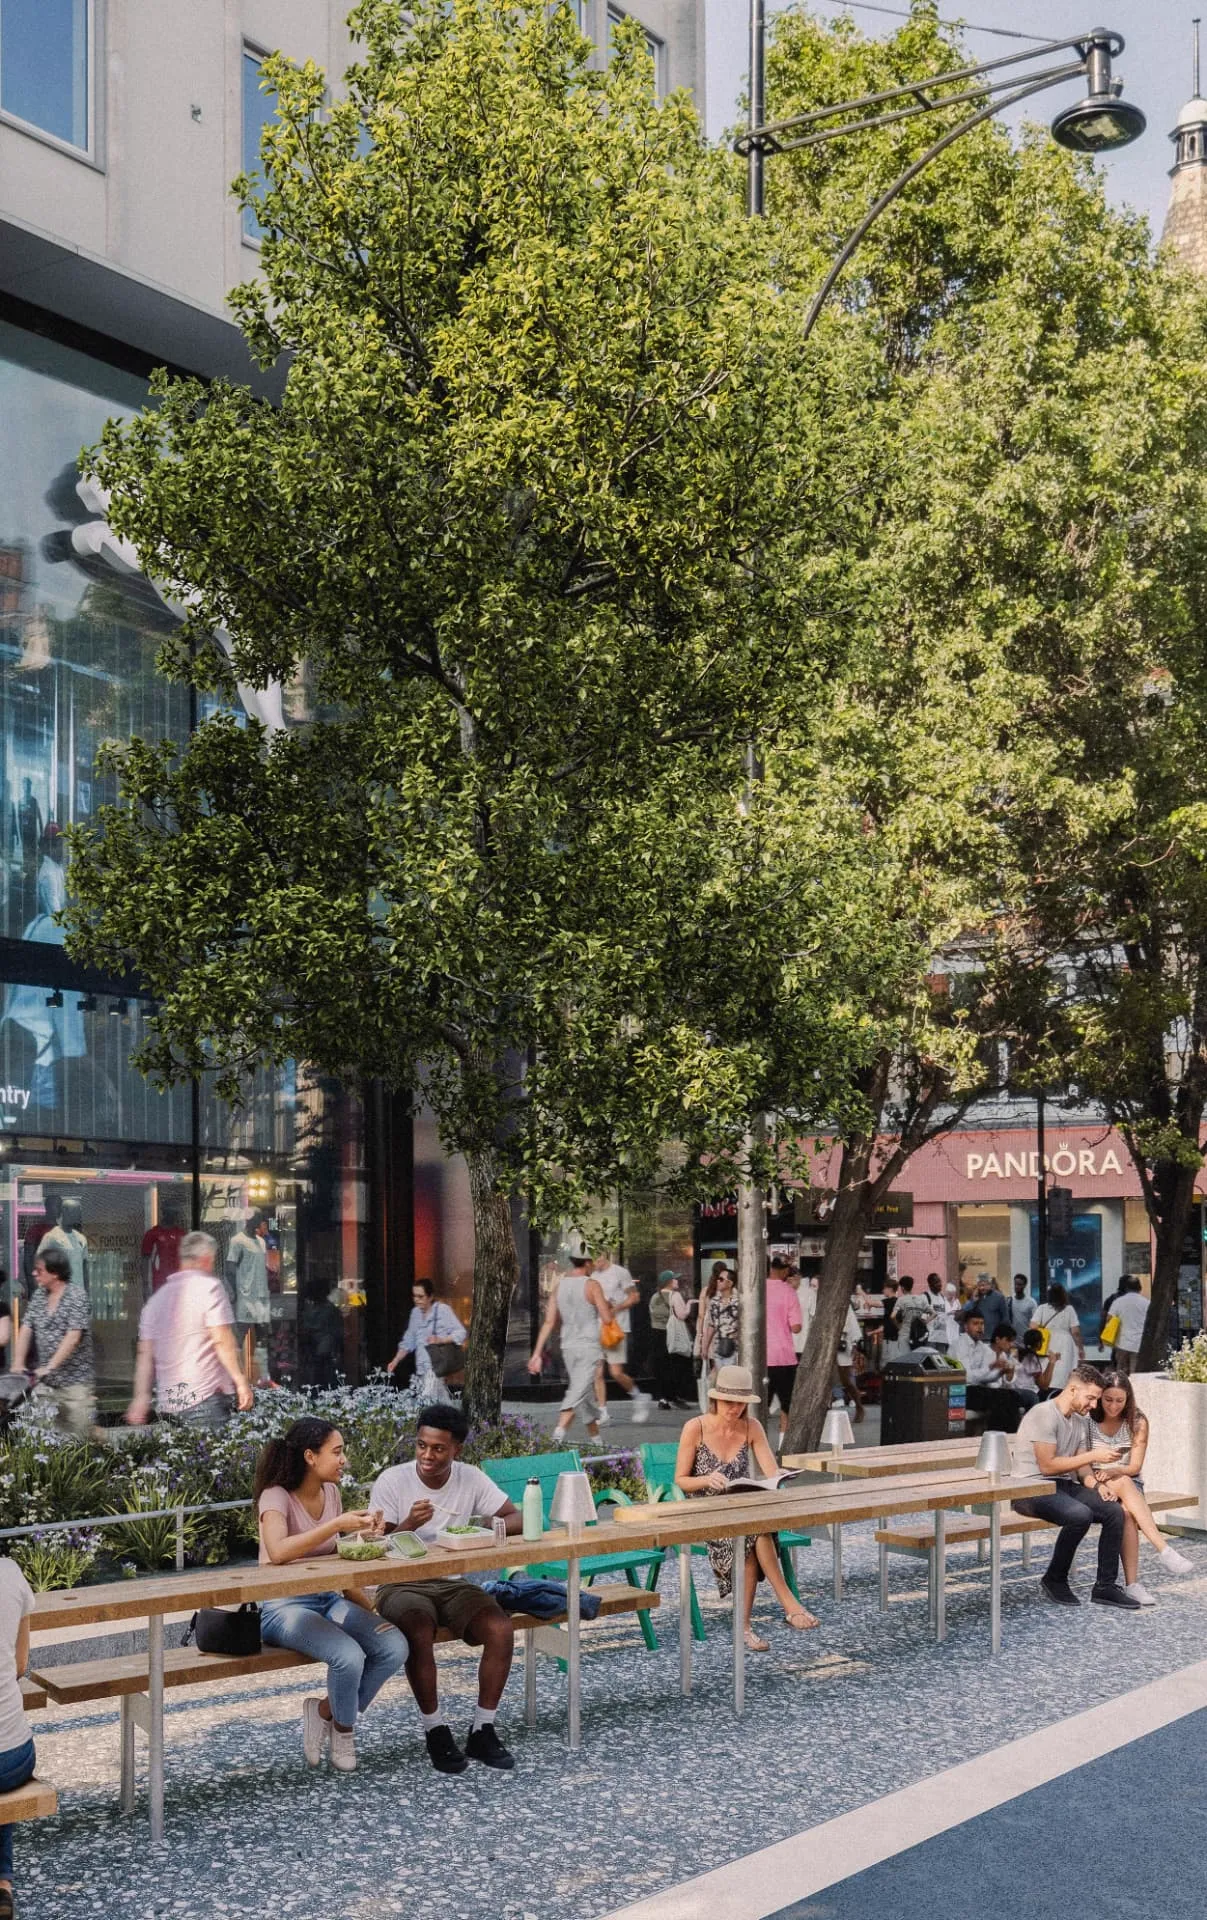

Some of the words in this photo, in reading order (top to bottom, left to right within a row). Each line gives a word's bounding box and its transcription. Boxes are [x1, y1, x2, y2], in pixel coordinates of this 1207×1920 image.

[967, 1150, 1124, 1179] PANDORA
[1048, 1258, 1064, 1268] UP
[1069, 1258, 1086, 1269] TO
